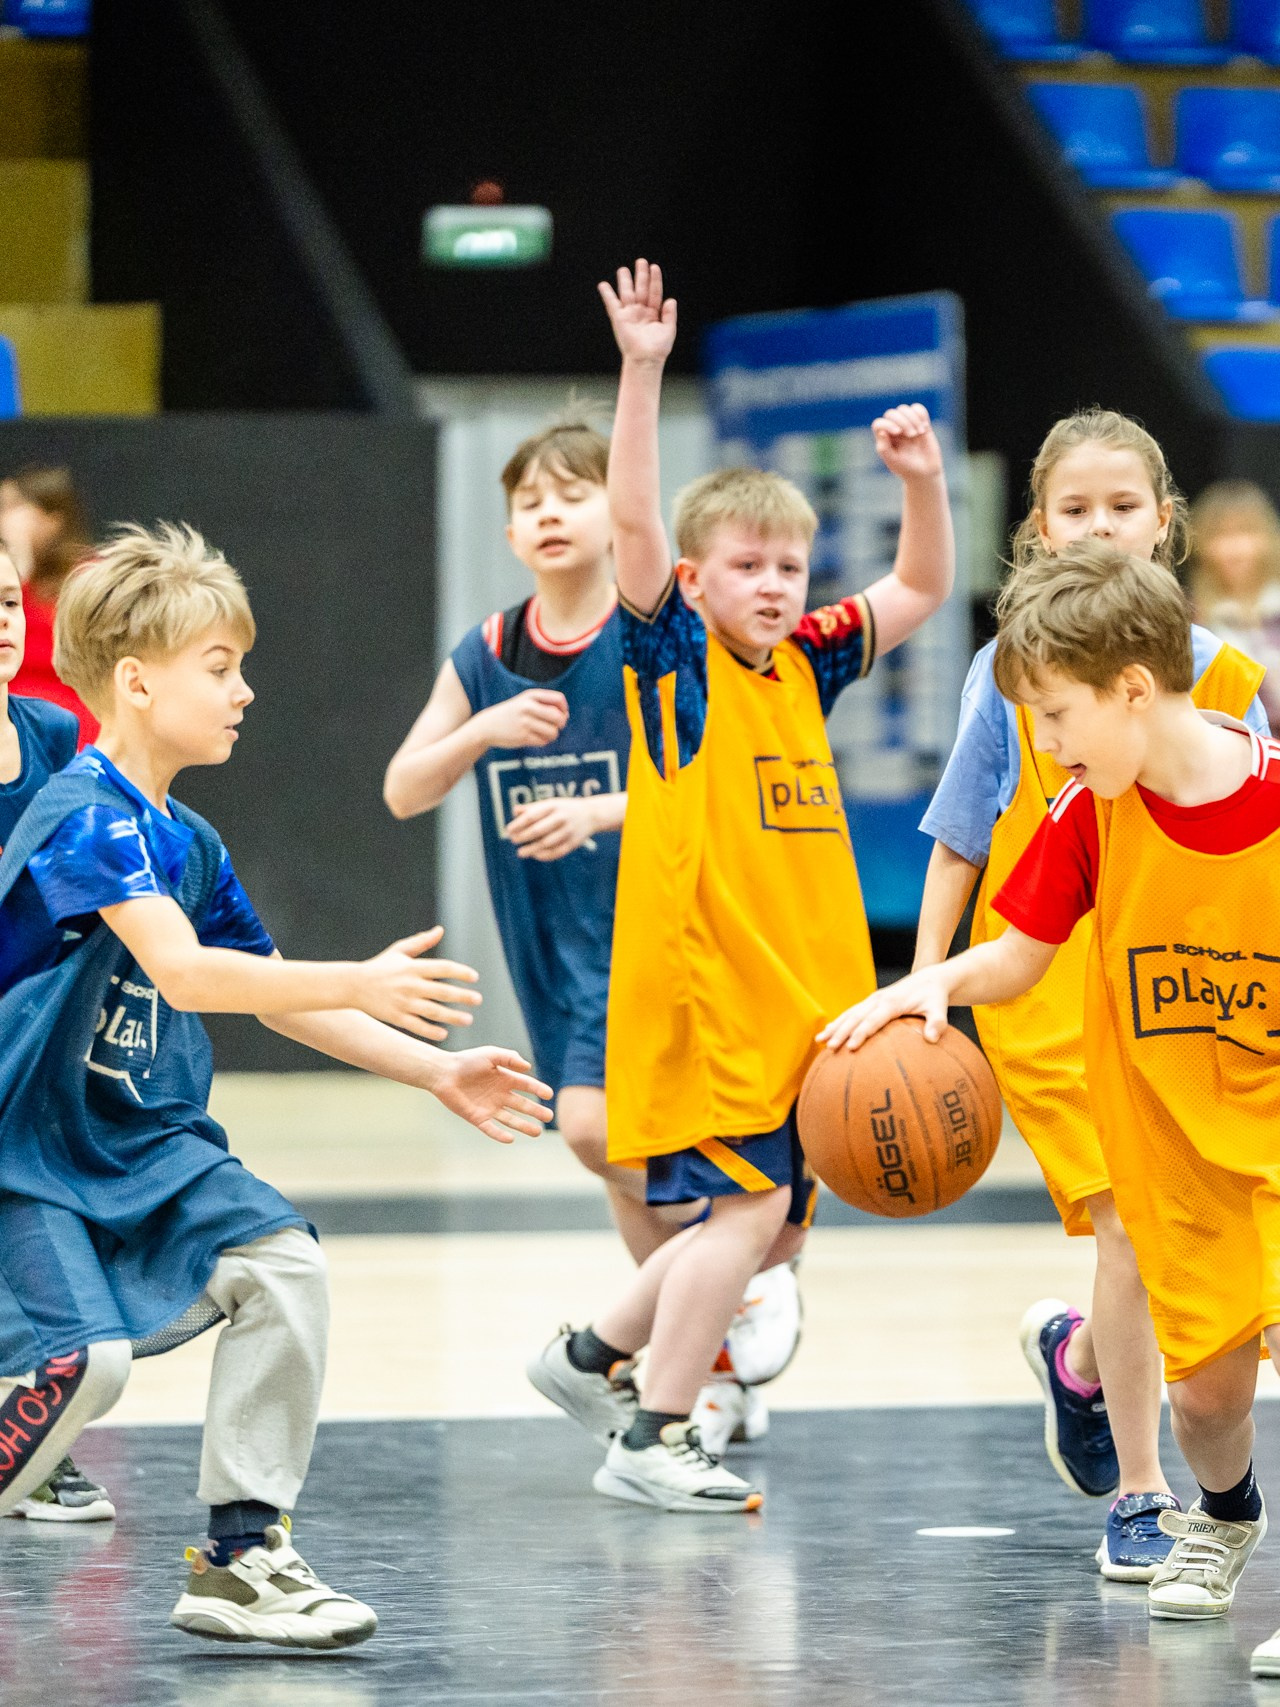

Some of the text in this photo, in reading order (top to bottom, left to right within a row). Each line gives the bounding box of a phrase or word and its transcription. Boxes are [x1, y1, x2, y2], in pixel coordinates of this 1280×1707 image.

[1173, 943, 1248, 962] SCHOOL
[871, 1088, 916, 1205] JÖGEL
[1187, 1522, 1218, 1534] TRIEN
